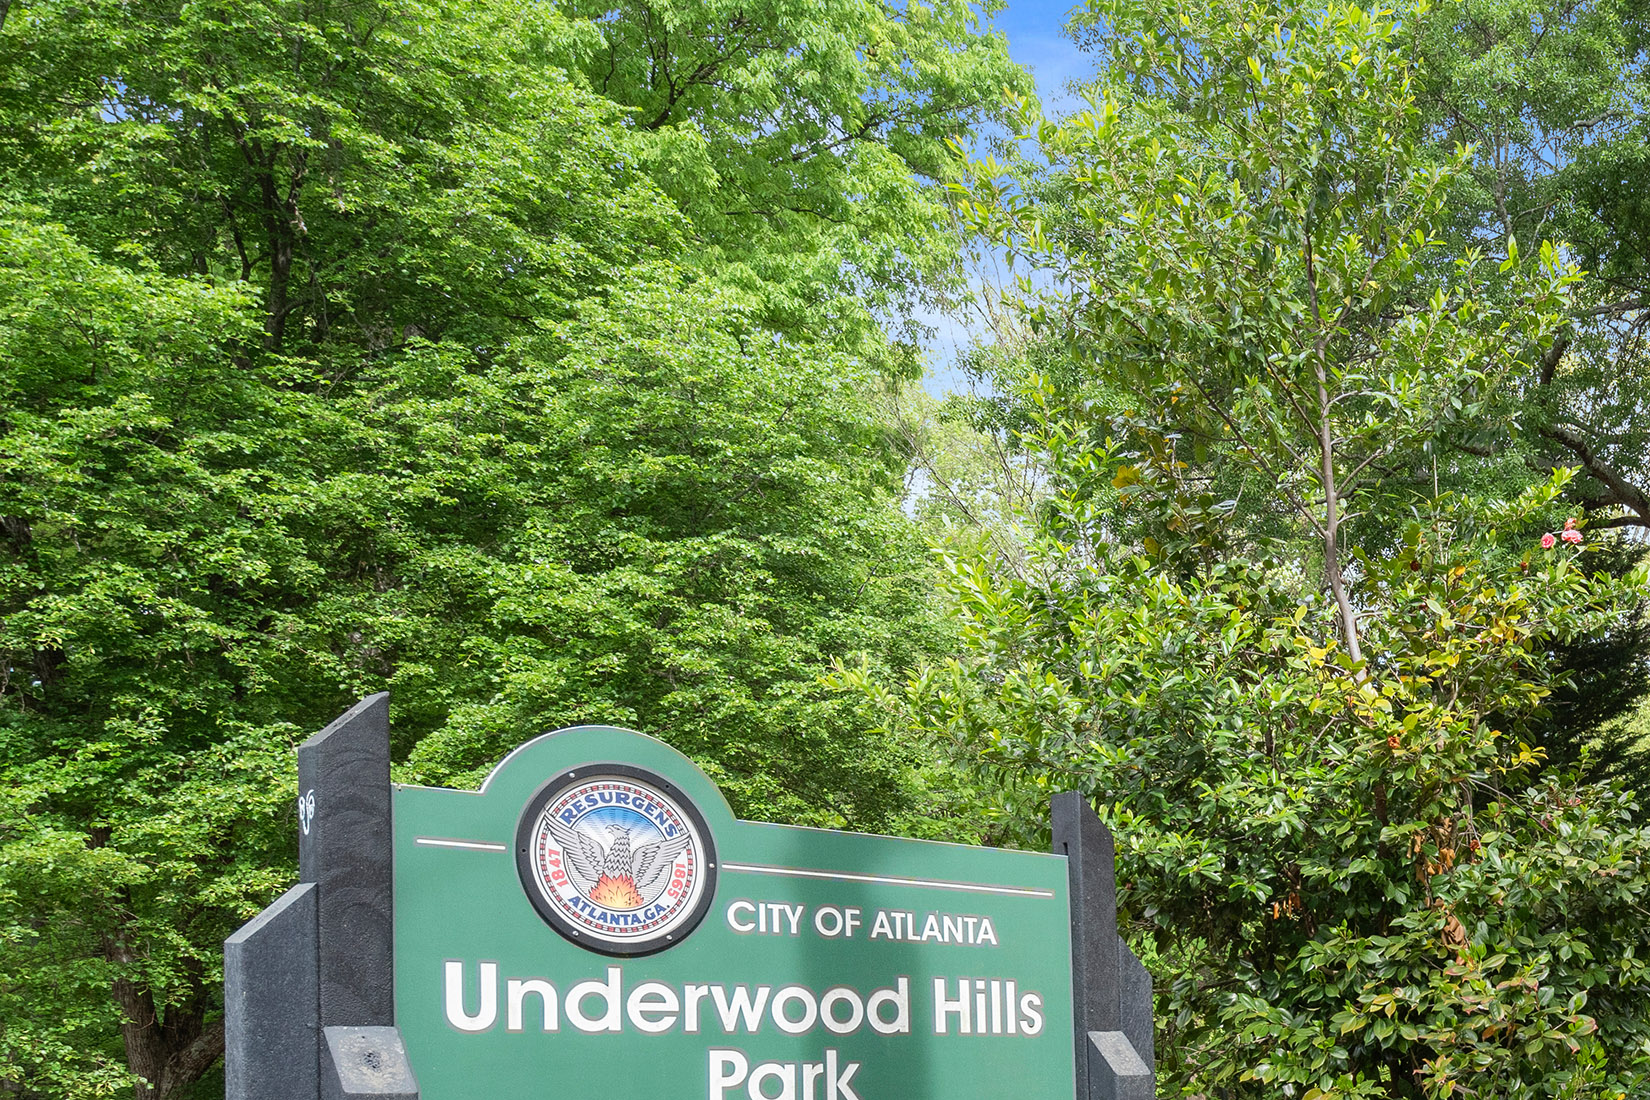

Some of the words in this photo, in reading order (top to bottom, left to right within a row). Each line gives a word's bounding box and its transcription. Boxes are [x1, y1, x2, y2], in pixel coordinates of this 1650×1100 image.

[559, 792, 678, 838] RESURGENS
[548, 849, 568, 888] 1847
[668, 863, 686, 899] 1865
[727, 901, 804, 934] CITY
[814, 906, 861, 937] OF
[870, 911, 998, 945] ATLANTA
[444, 961, 910, 1033] Underwood
[932, 977, 1045, 1035] Hills
